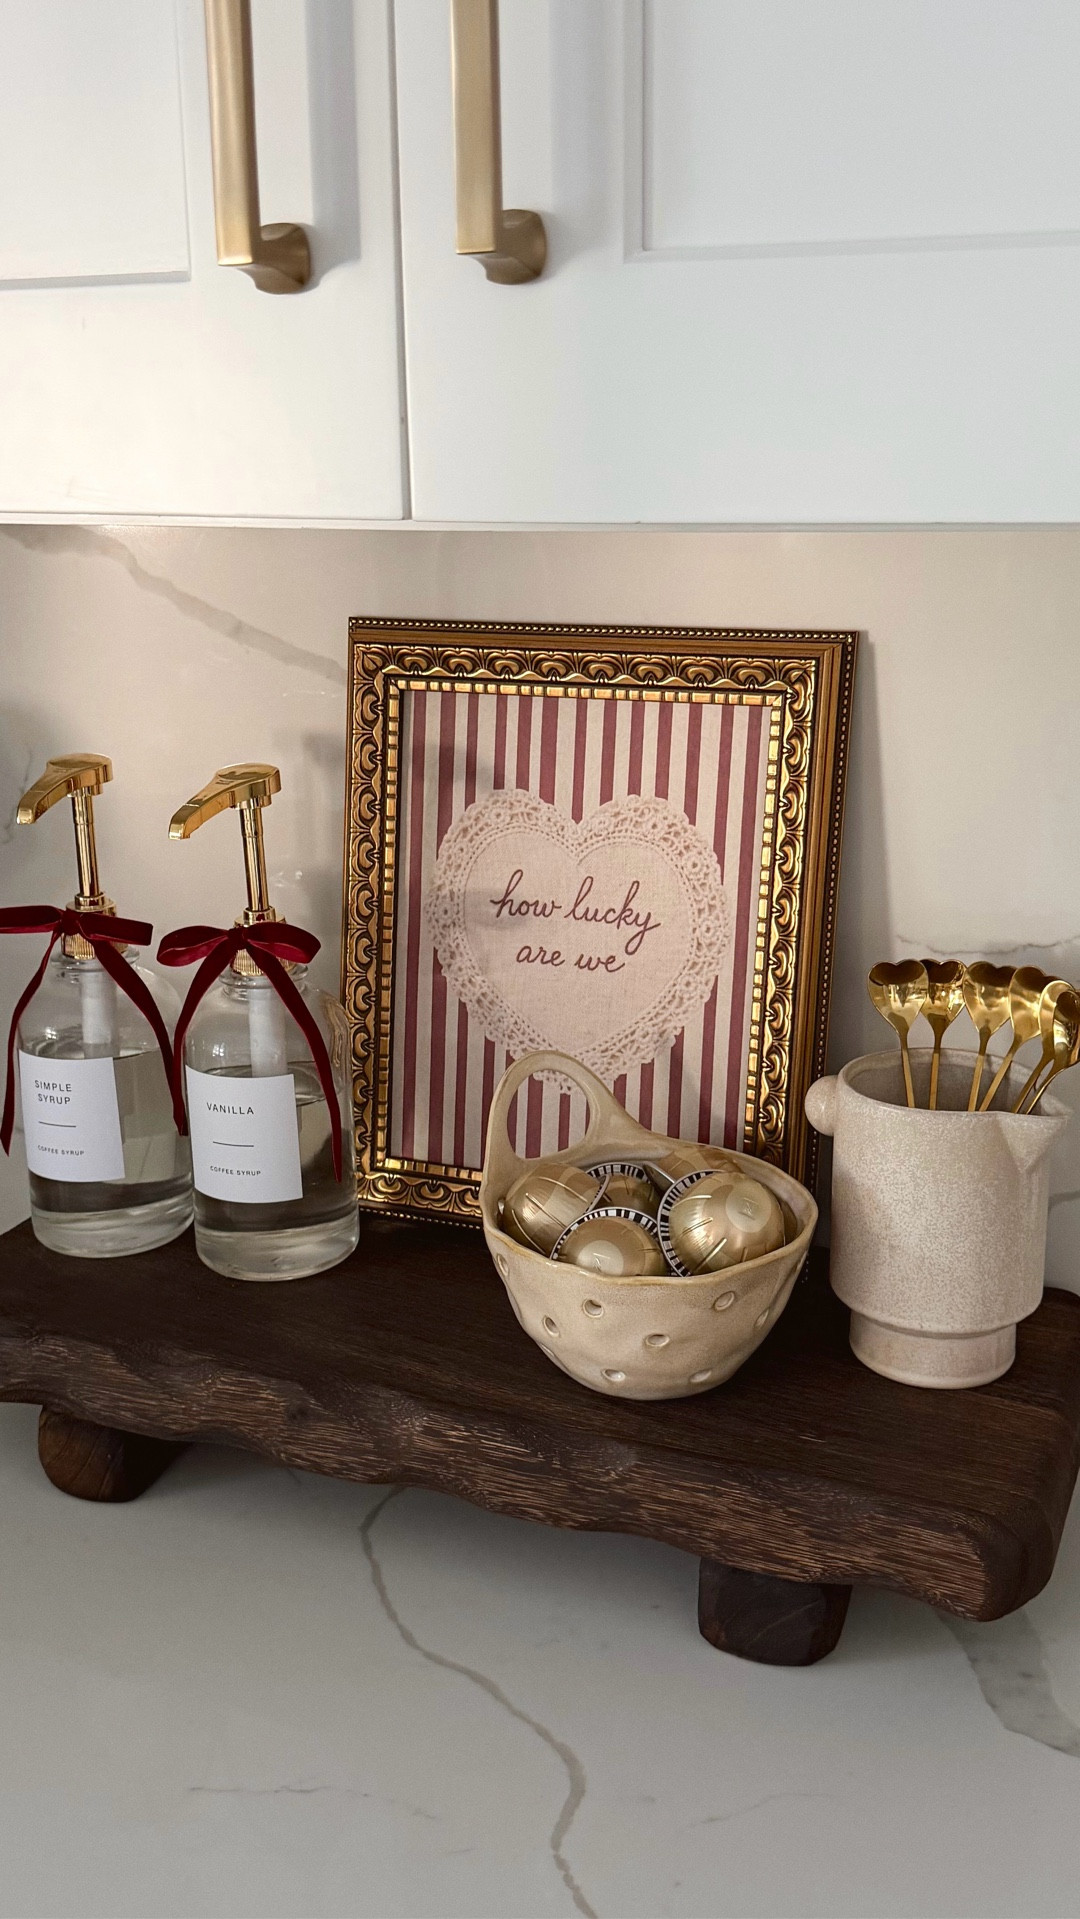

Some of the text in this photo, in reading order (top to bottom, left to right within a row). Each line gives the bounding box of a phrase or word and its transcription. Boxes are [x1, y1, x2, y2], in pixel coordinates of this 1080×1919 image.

[490, 869, 661, 955] how lucky
[516, 945, 625, 973] are we
[34, 1079, 72, 1093] SIMPLE
[37, 1093, 71, 1105] SYRUP
[206, 1101, 255, 1115] VANILLA
[37, 1144, 59, 1155] COFFEE
[209, 1165, 261, 1177] COFFEE SYRUP
